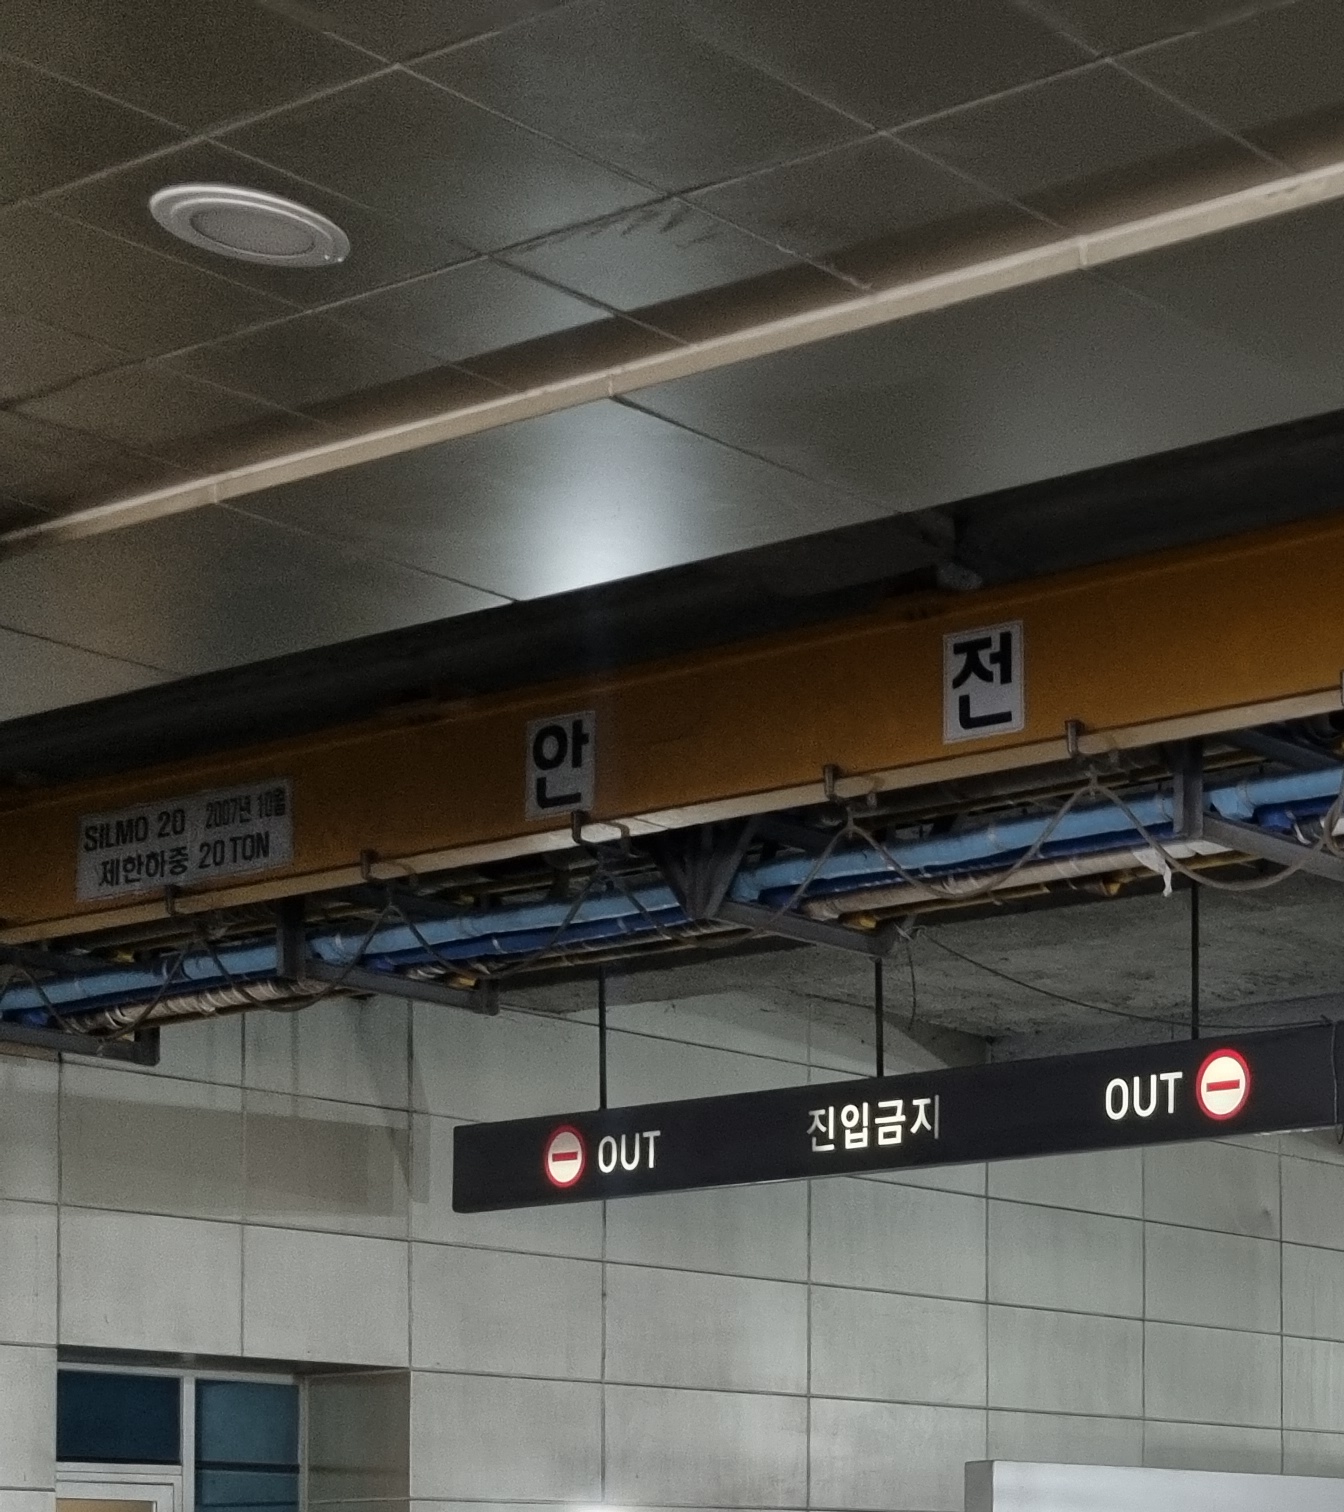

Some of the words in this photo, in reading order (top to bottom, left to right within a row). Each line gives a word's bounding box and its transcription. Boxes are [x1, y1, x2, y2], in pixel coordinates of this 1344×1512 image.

[84, 817, 149, 852] SILMO
[157, 808, 186, 839] 20
[99, 846, 189, 887] 제한하중
[198, 838, 225, 869] 20
[231, 831, 270, 864] TON
[1104, 1072, 1184, 1122] OUT
[806, 1095, 941, 1152] 진입금지
[597, 1130, 661, 1174] OUT
